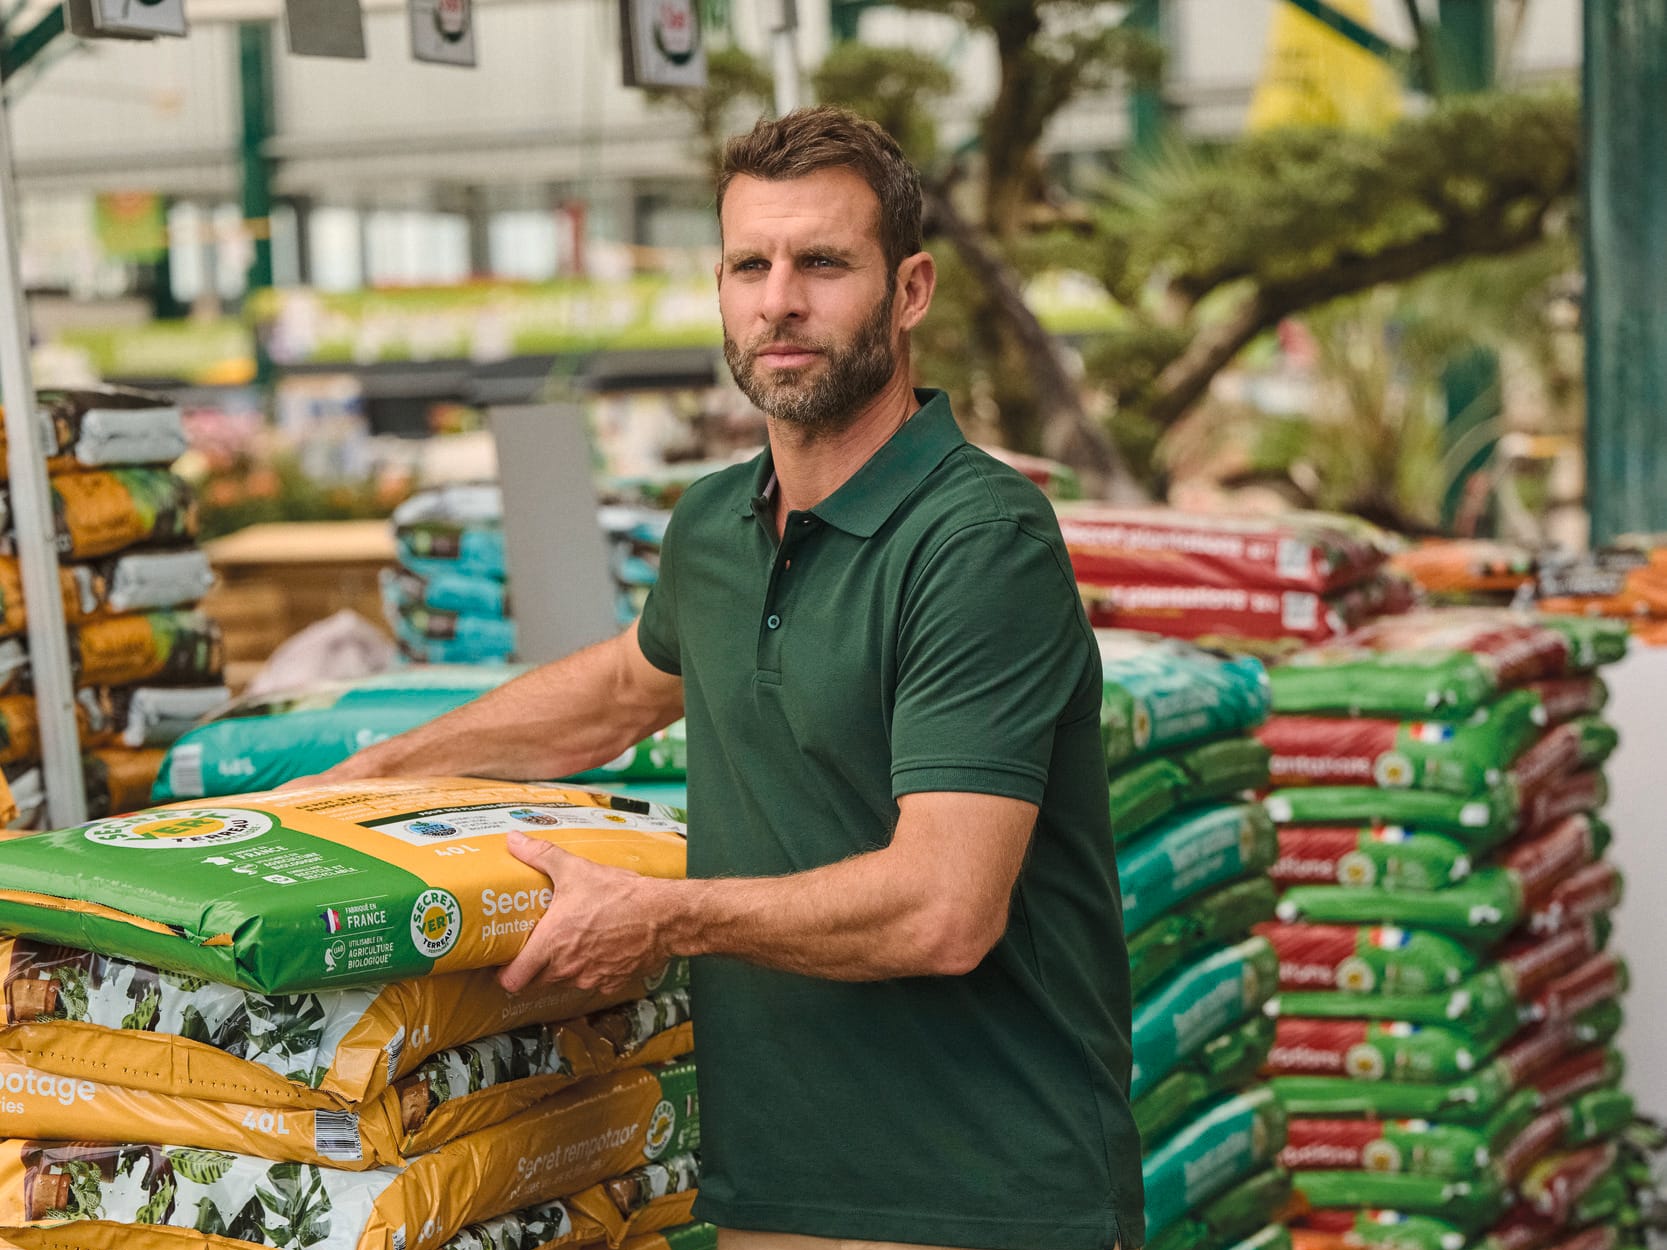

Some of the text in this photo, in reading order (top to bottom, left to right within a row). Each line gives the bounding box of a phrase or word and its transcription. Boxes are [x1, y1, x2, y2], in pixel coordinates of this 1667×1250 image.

[126, 812, 229, 841] VERT
[172, 819, 248, 843] TERREAU
[413, 892, 455, 923] SECRET
[346, 910, 387, 928] FRANCE
[417, 911, 453, 935] VERT
[375, 936, 383, 944] EN
[423, 929, 453, 949] TERREAU
[348, 943, 394, 958] AGRICULTURE
